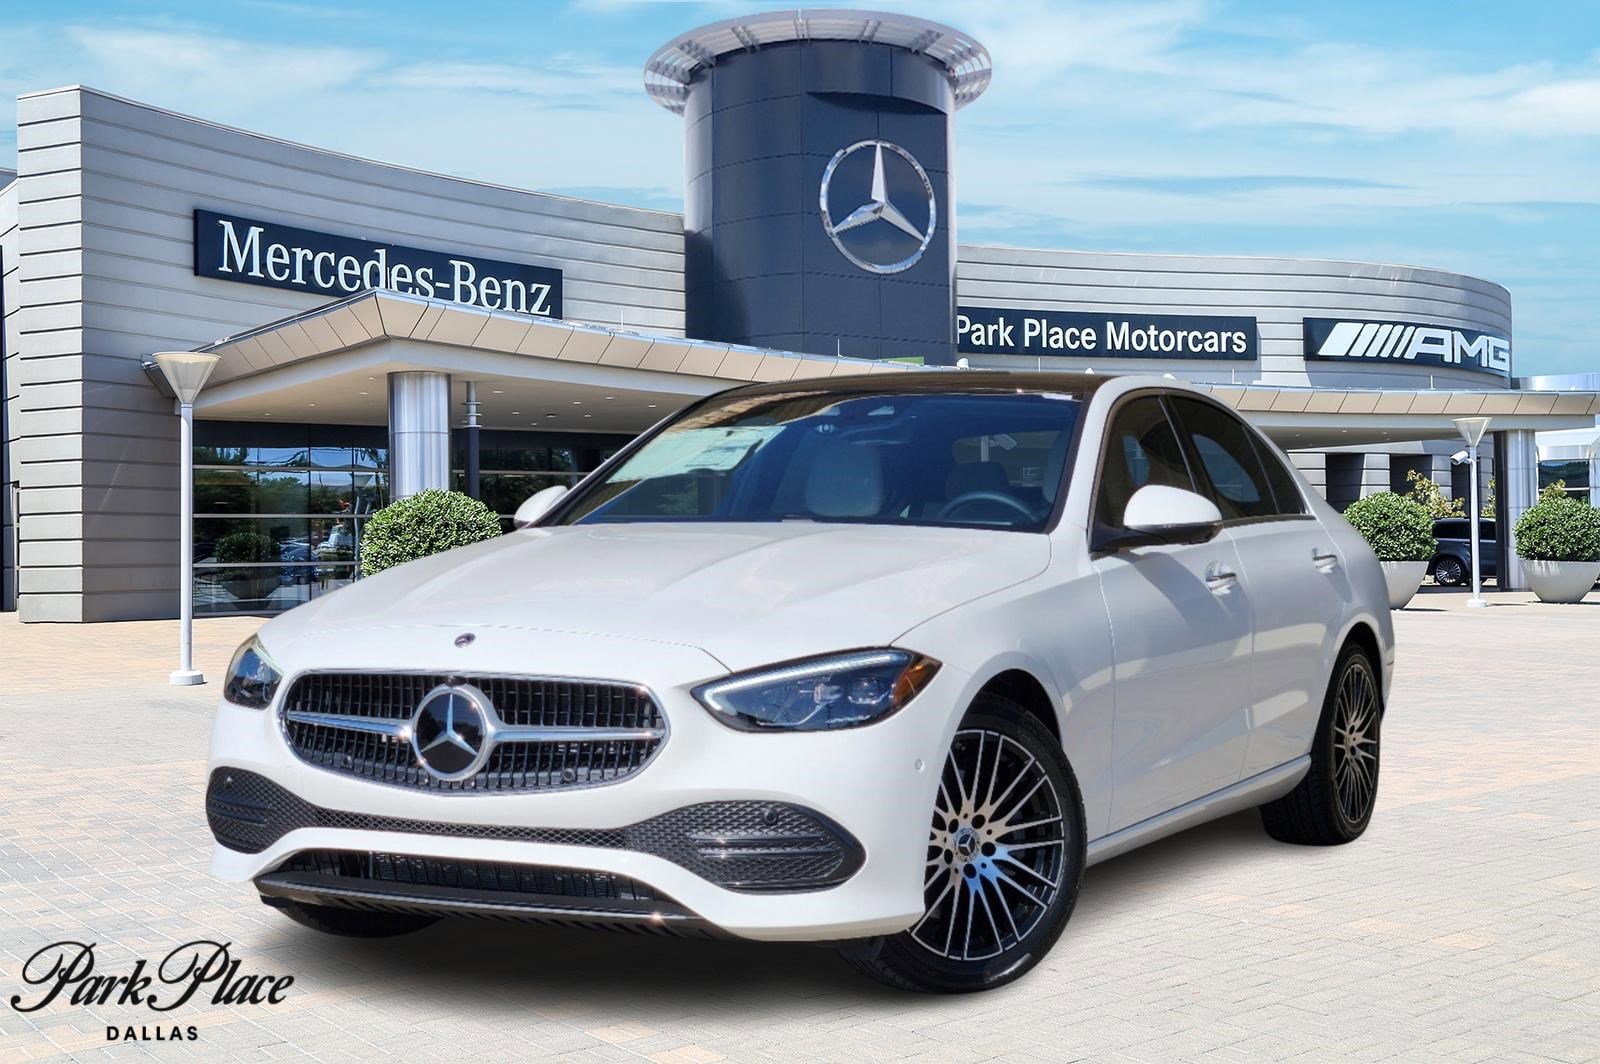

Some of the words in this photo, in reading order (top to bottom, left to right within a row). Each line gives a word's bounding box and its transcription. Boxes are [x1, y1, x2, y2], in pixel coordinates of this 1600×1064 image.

[217, 219, 552, 316] Mercedes-Benz
[957, 315, 1015, 348] Park
[1024, 317, 1097, 350] Place
[1106, 320, 1248, 353] Motorcars
[1403, 326, 1510, 372] AMG
